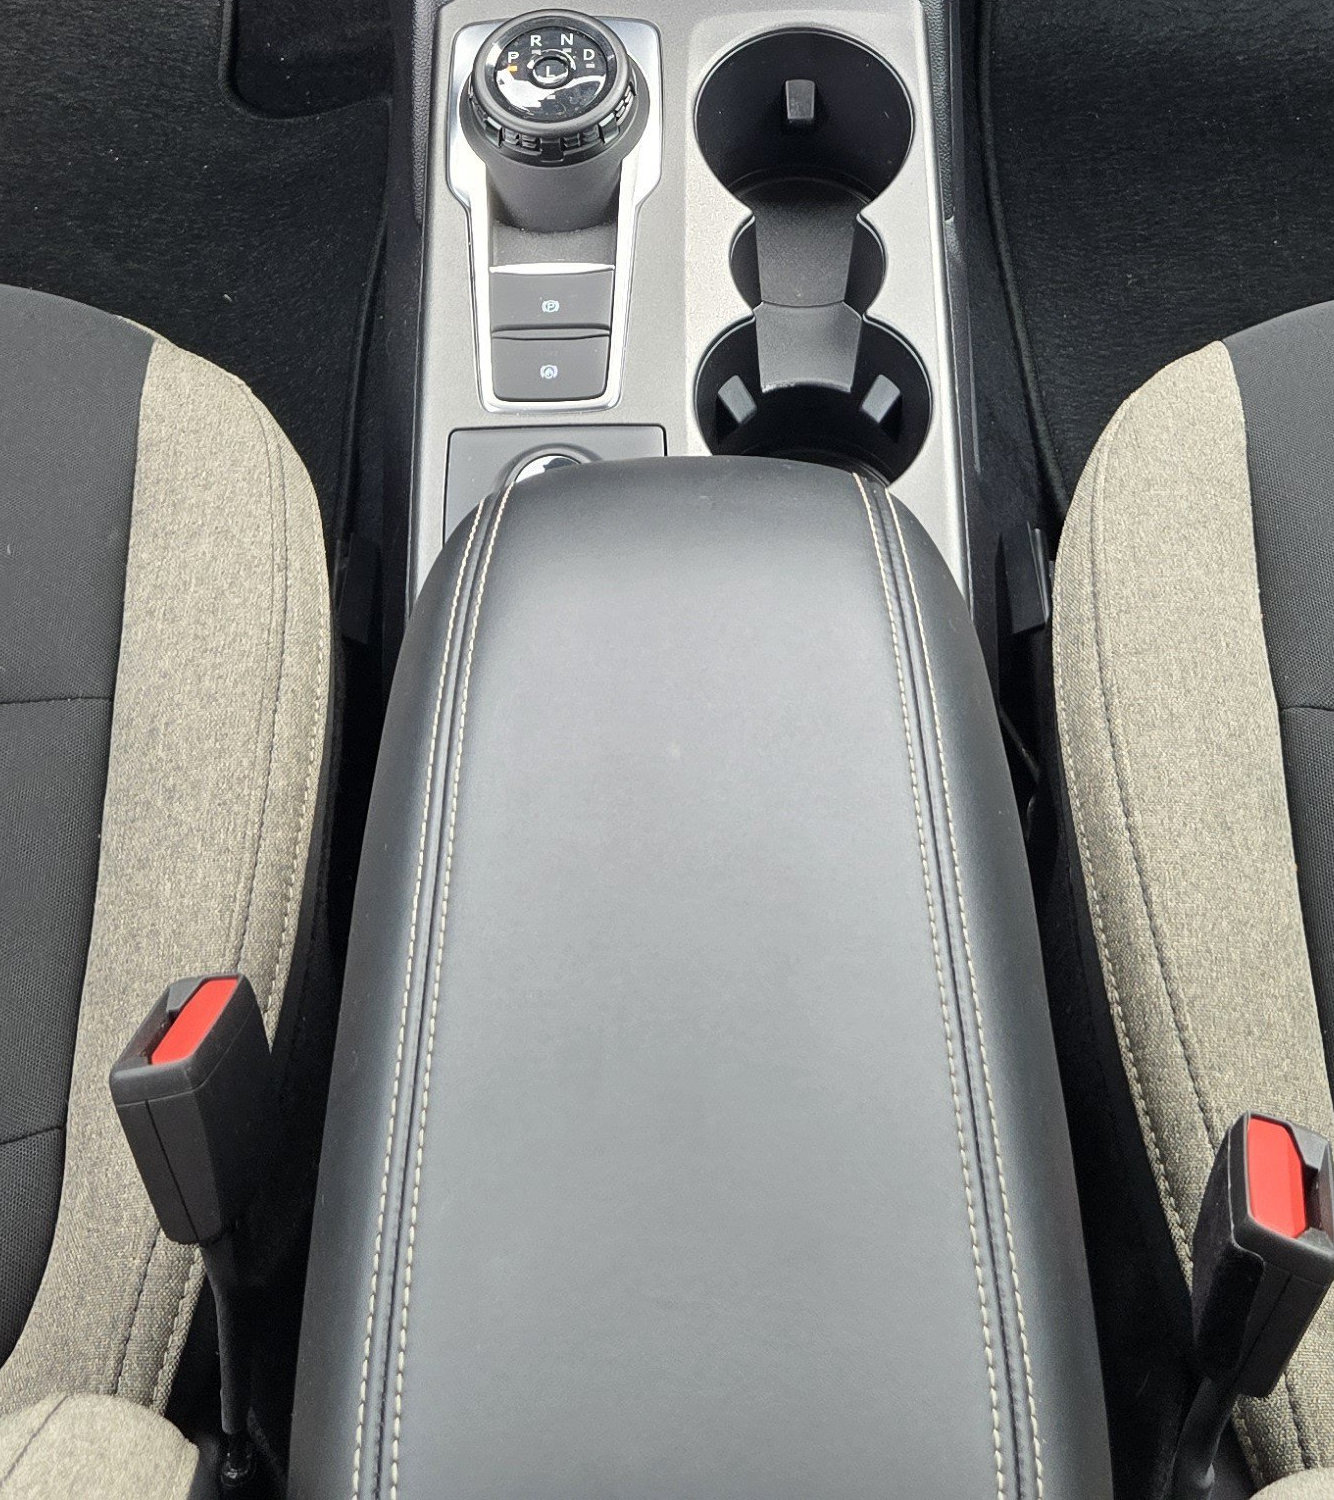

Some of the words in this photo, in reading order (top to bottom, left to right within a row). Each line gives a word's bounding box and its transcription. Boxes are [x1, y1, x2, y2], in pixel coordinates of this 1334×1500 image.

[530, 35, 542, 46] R
[561, 34, 574, 45] N
[507, 51, 519, 63] P
[583, 49, 595, 61] D
[546, 66, 555, 78] L
